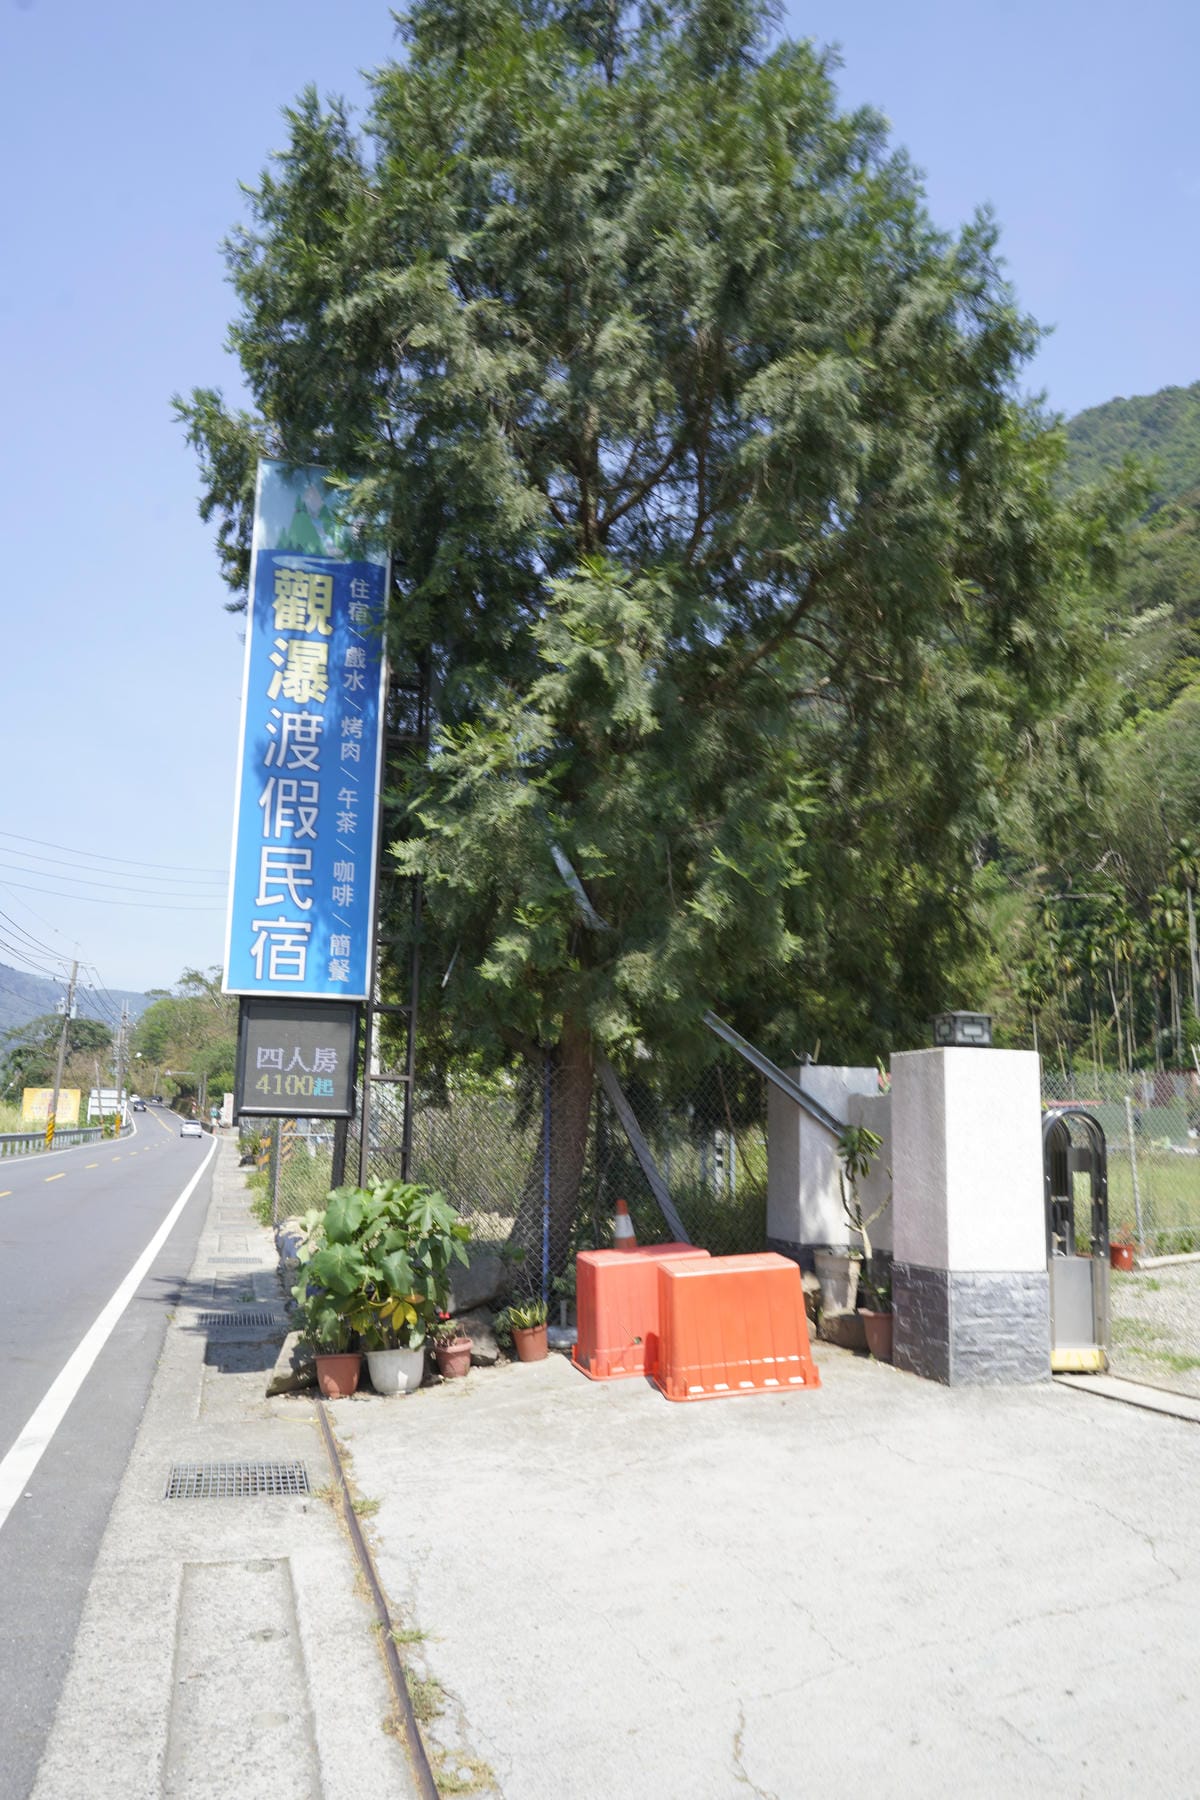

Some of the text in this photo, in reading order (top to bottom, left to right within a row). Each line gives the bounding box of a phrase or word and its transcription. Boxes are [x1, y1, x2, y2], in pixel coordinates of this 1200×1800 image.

[249, 567, 334, 982] 觀瀑渡假民宿
[256, 1046, 339, 1074] 四人房
[255, 1073, 335, 1097] 4100起
